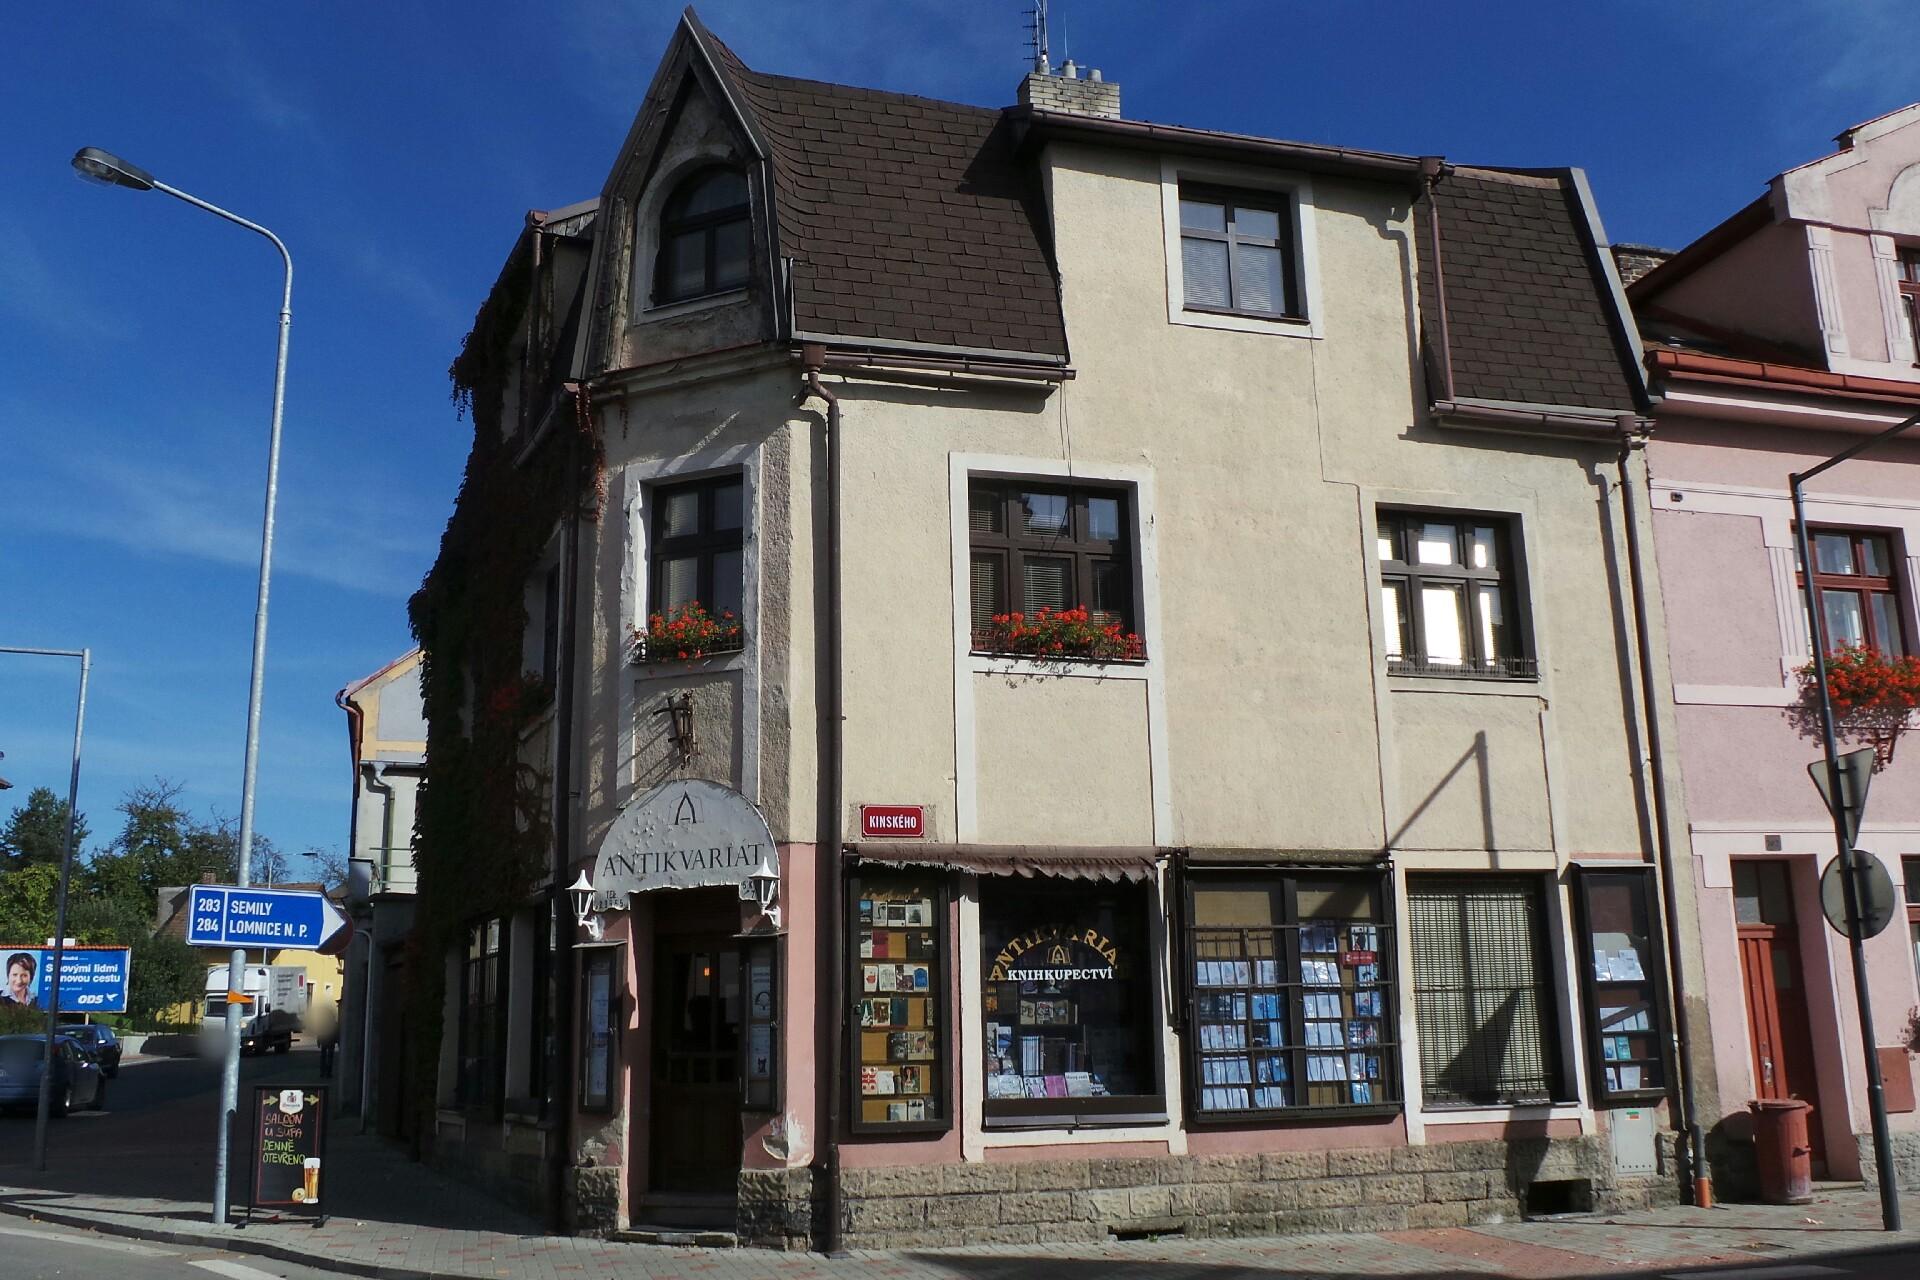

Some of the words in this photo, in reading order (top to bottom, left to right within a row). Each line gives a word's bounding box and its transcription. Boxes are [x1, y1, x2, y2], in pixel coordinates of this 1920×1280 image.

[869, 813, 917, 829] KINSKÉHO
[602, 839, 765, 877] ANTIKVARIÁT
[198, 898, 221, 913] 283
[230, 900, 273, 916] SEMILY
[196, 917, 219, 932] 284
[229, 919, 282, 936] LOMNICE
[284, 923, 296, 937] N.
[299, 924, 308, 937] P.
[60, 963, 91, 974] ovými
[94, 963, 118, 973] lidmi
[1007, 966, 1114, 981] KNIHKUPECTVÍ
[60, 975, 90, 983] novou
[93, 974, 120, 983] cestu
[78, 995, 104, 1004] ODS
[262, 1138, 295, 1152] DENNĚ
[262, 1151, 306, 1165] OTEVŘENO
